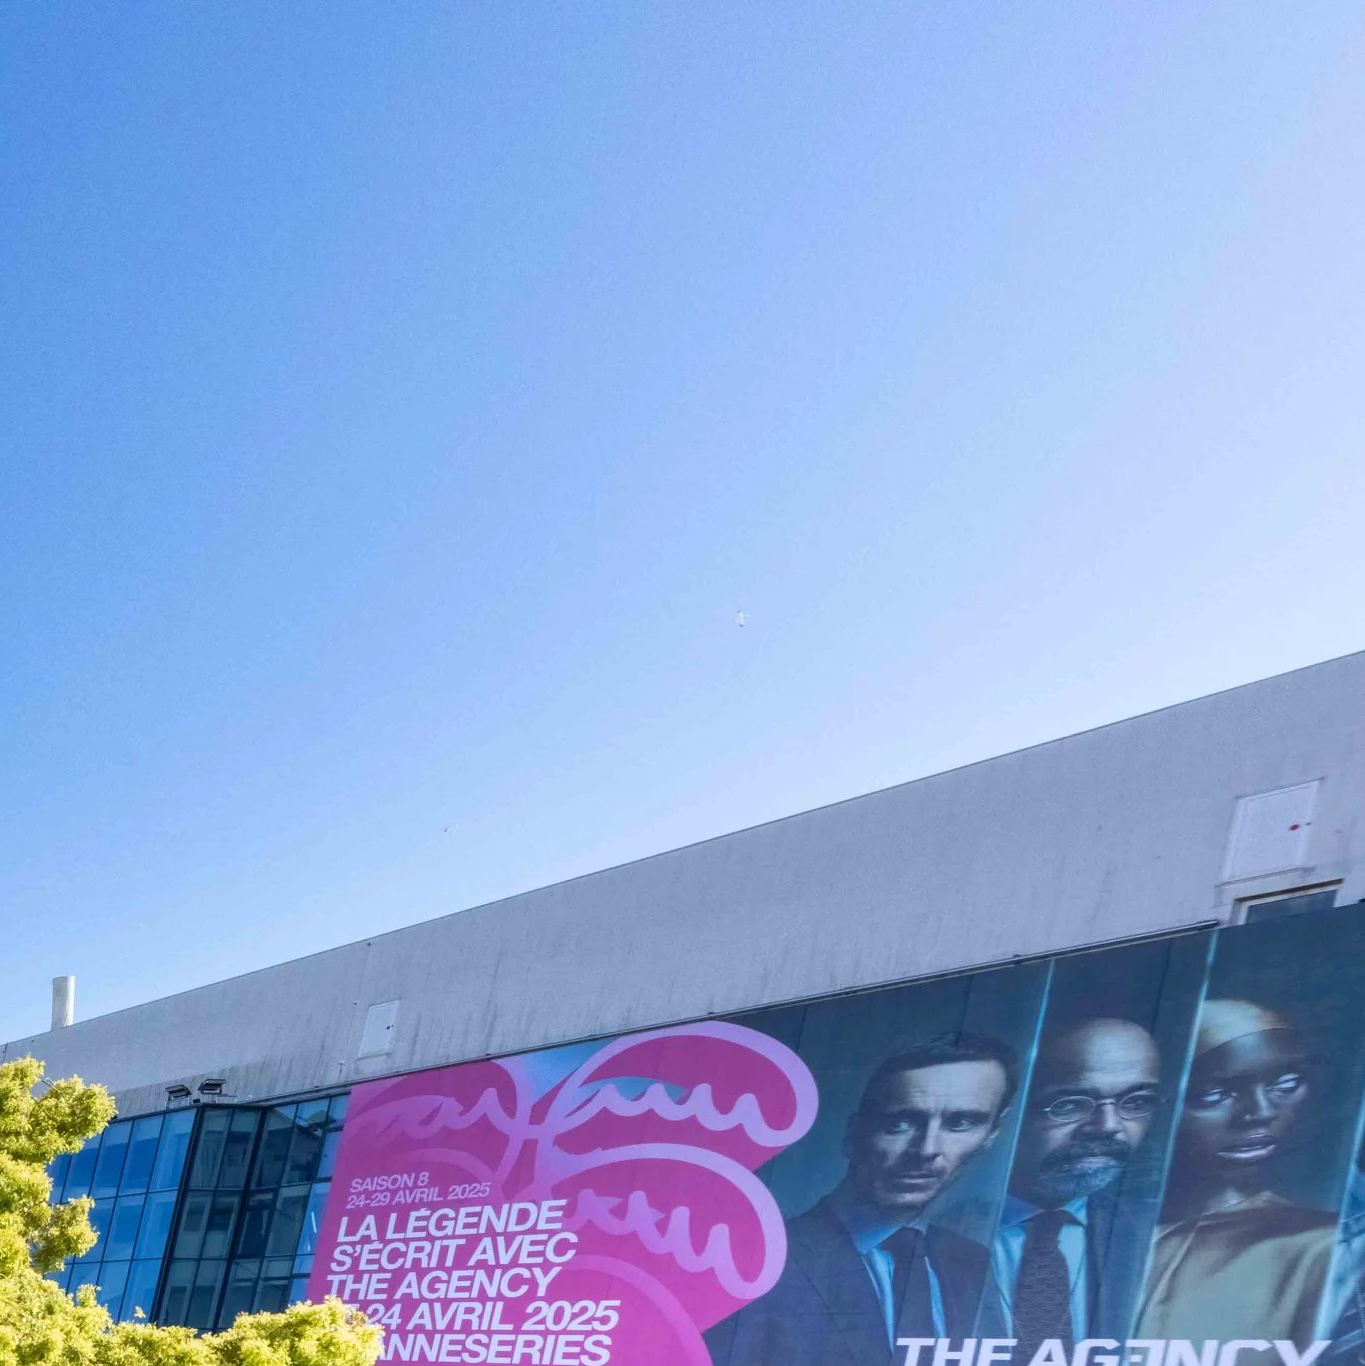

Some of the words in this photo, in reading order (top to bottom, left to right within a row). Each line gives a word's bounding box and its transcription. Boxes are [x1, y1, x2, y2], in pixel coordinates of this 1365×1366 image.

[346, 1191, 390, 1209] 24-29
[392, 1187, 443, 1206] AVRIL
[447, 1182, 491, 1200] 2025
[350, 1173, 415, 1193] SAISON
[418, 1171, 429, 1187] 8
[336, 1213, 378, 1243] LA
[385, 1199, 568, 1240] LÉGENDE
[467, 1231, 579, 1267] AVEC
[326, 1271, 392, 1300] THE
[394, 1265, 563, 1300] AGENCY
[365, 1303, 402, 1331] 24
[406, 1301, 515, 1332] AVRIL
[521, 1299, 622, 1332] 2025
[378, 1333, 613, 1366] NNESERIES
